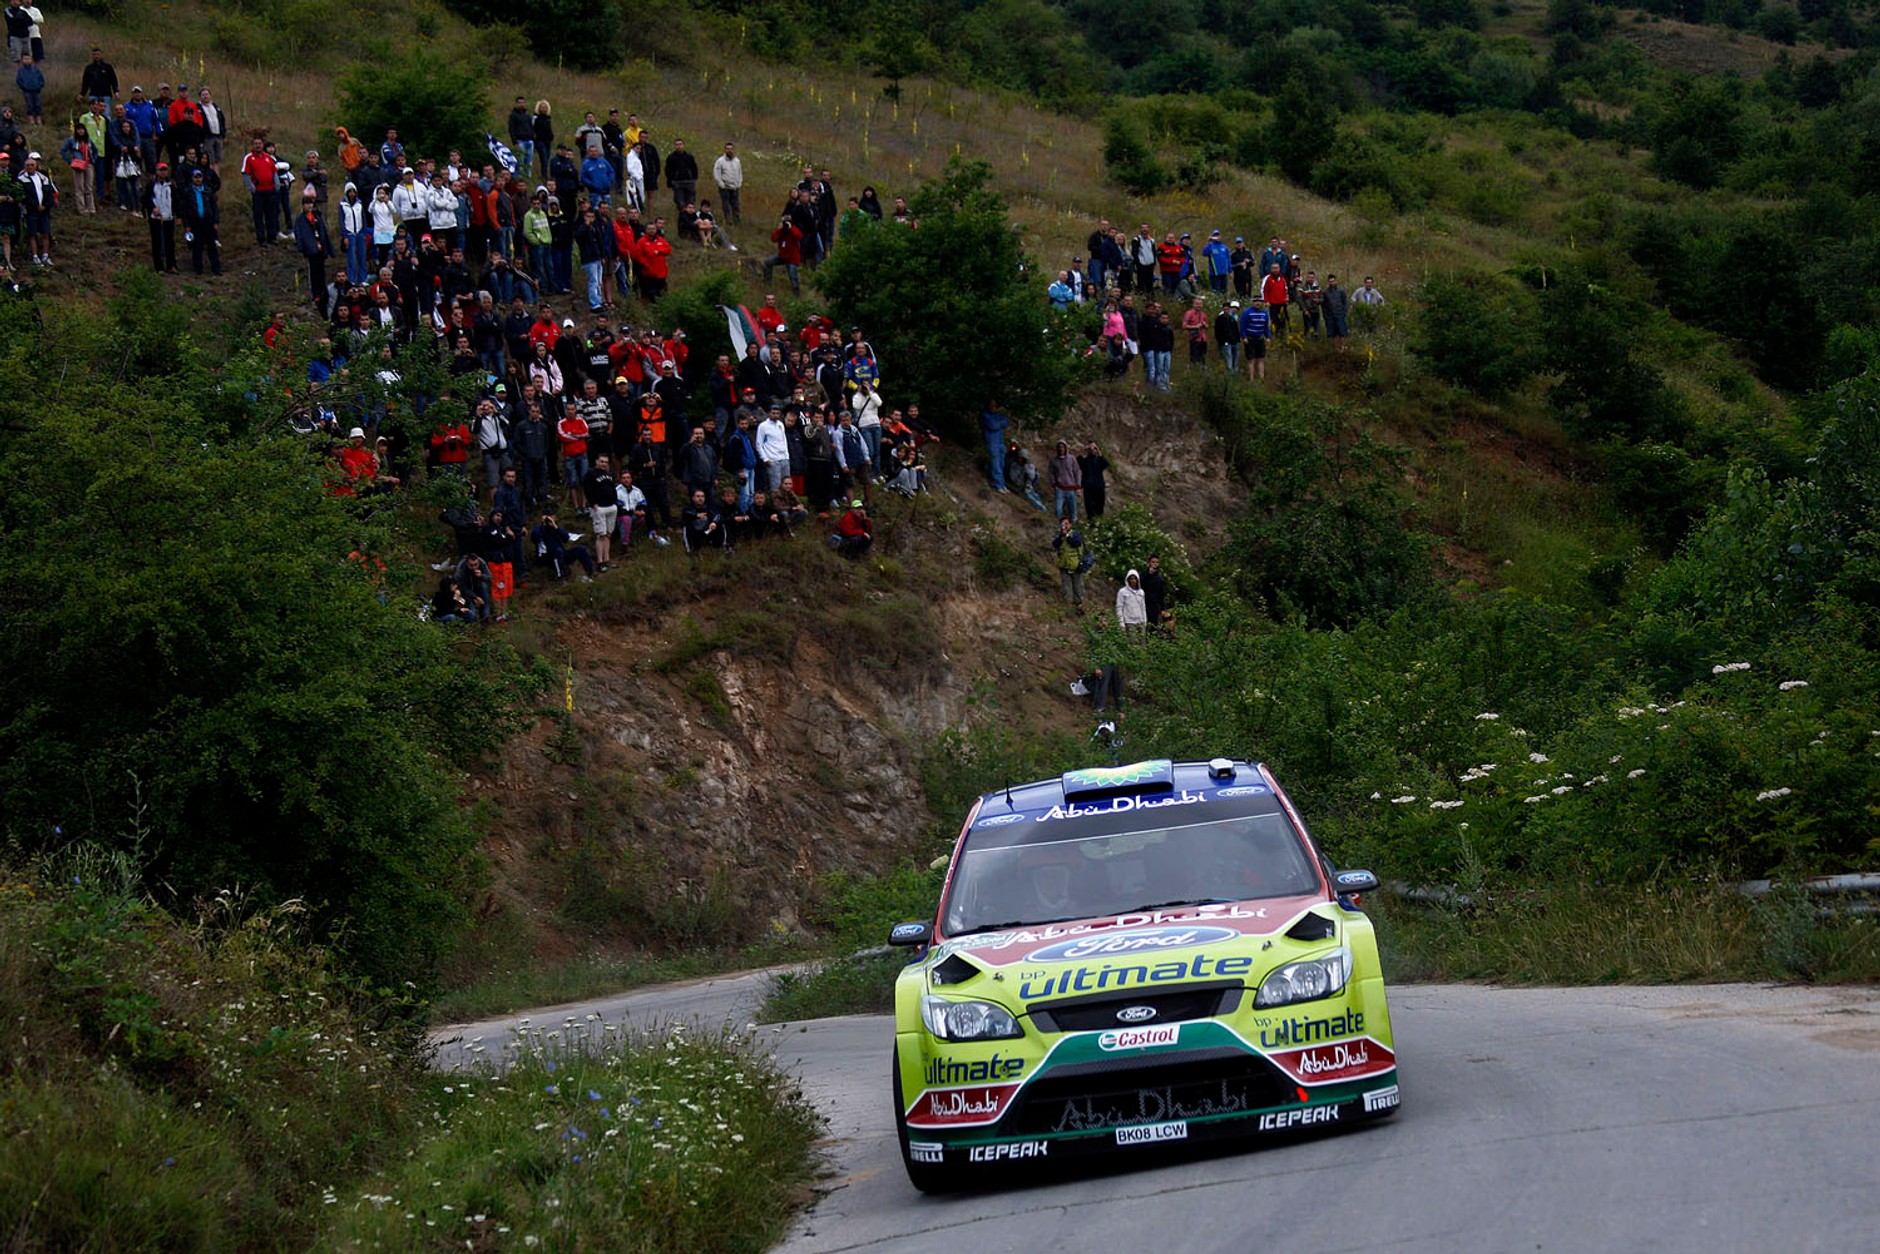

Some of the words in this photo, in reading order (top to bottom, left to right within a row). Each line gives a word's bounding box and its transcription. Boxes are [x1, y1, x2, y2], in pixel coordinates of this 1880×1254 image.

[1064, 930, 1198, 957] Ford
[1019, 955, 1252, 999] ultimate
[1021, 971, 1046, 980] bp
[1119, 1028, 1174, 1047] Castrol
[1261, 1007, 1364, 1047] ultimate
[924, 1053, 1025, 1084] ultimate
[1258, 1104, 1340, 1131] ICEPEAK
[1118, 1128, 1151, 1142] BK08
[1156, 1124, 1185, 1138] LCW
[969, 1141, 1048, 1162] ICEPEAK
